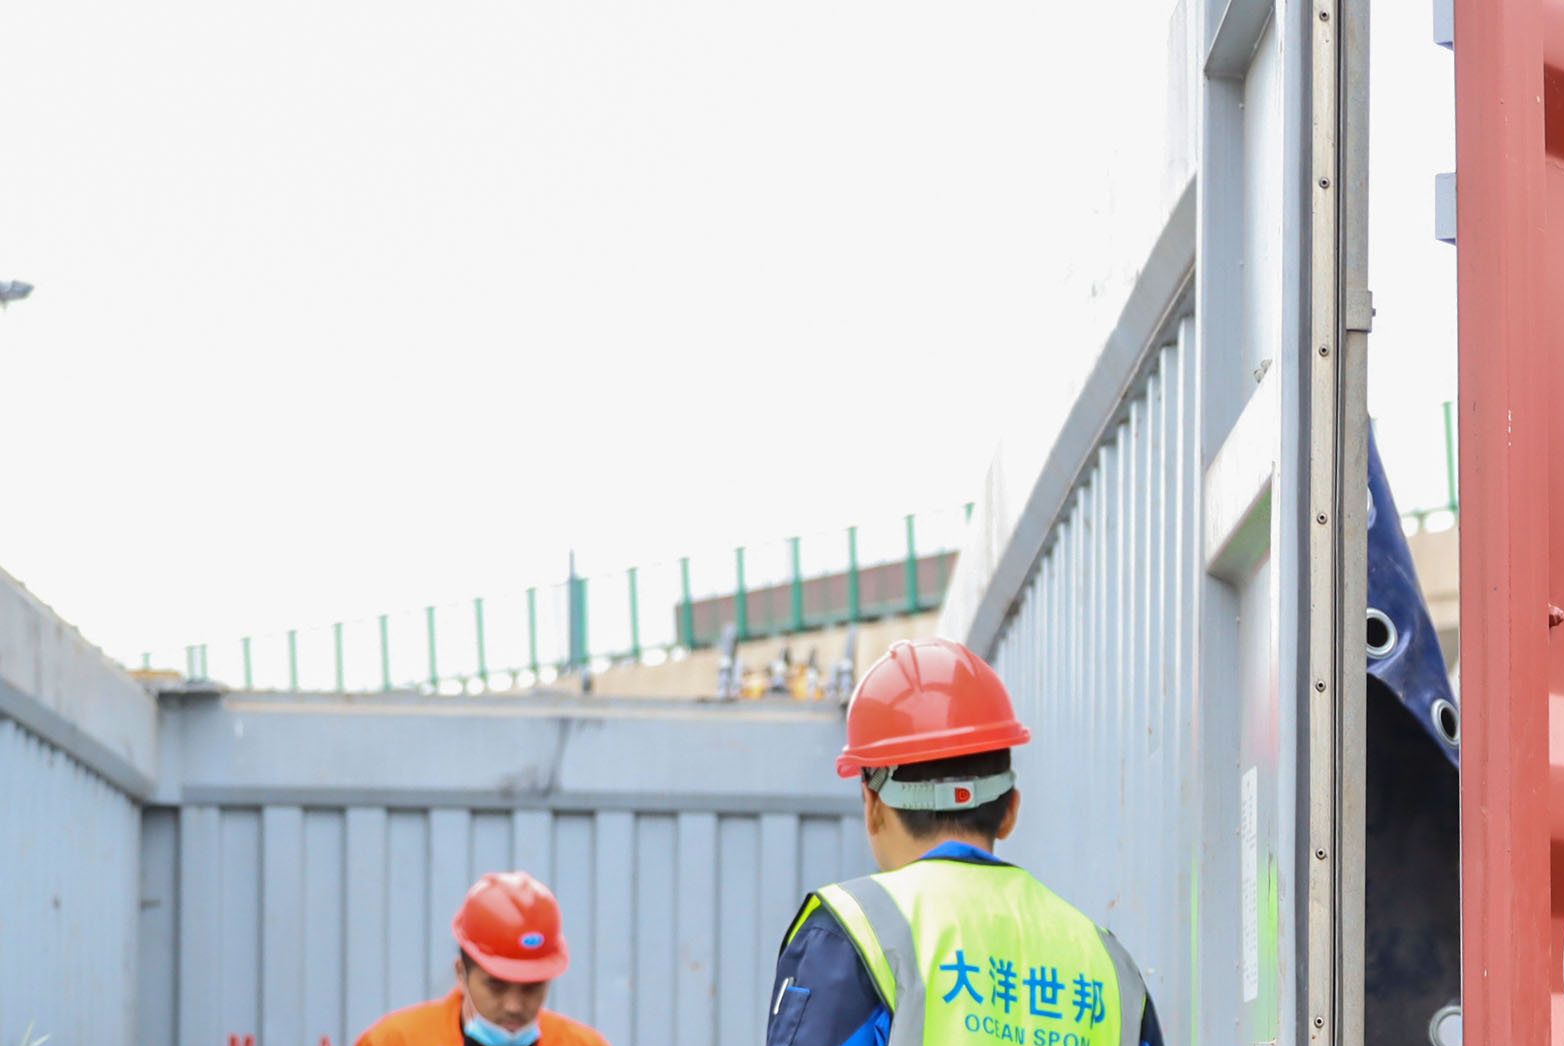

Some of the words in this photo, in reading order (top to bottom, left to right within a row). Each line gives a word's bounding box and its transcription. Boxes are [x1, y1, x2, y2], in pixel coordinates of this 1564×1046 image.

[939, 949, 1106, 1029] 大洋世邦
[964, 1013, 1025, 1045] OCEAN
